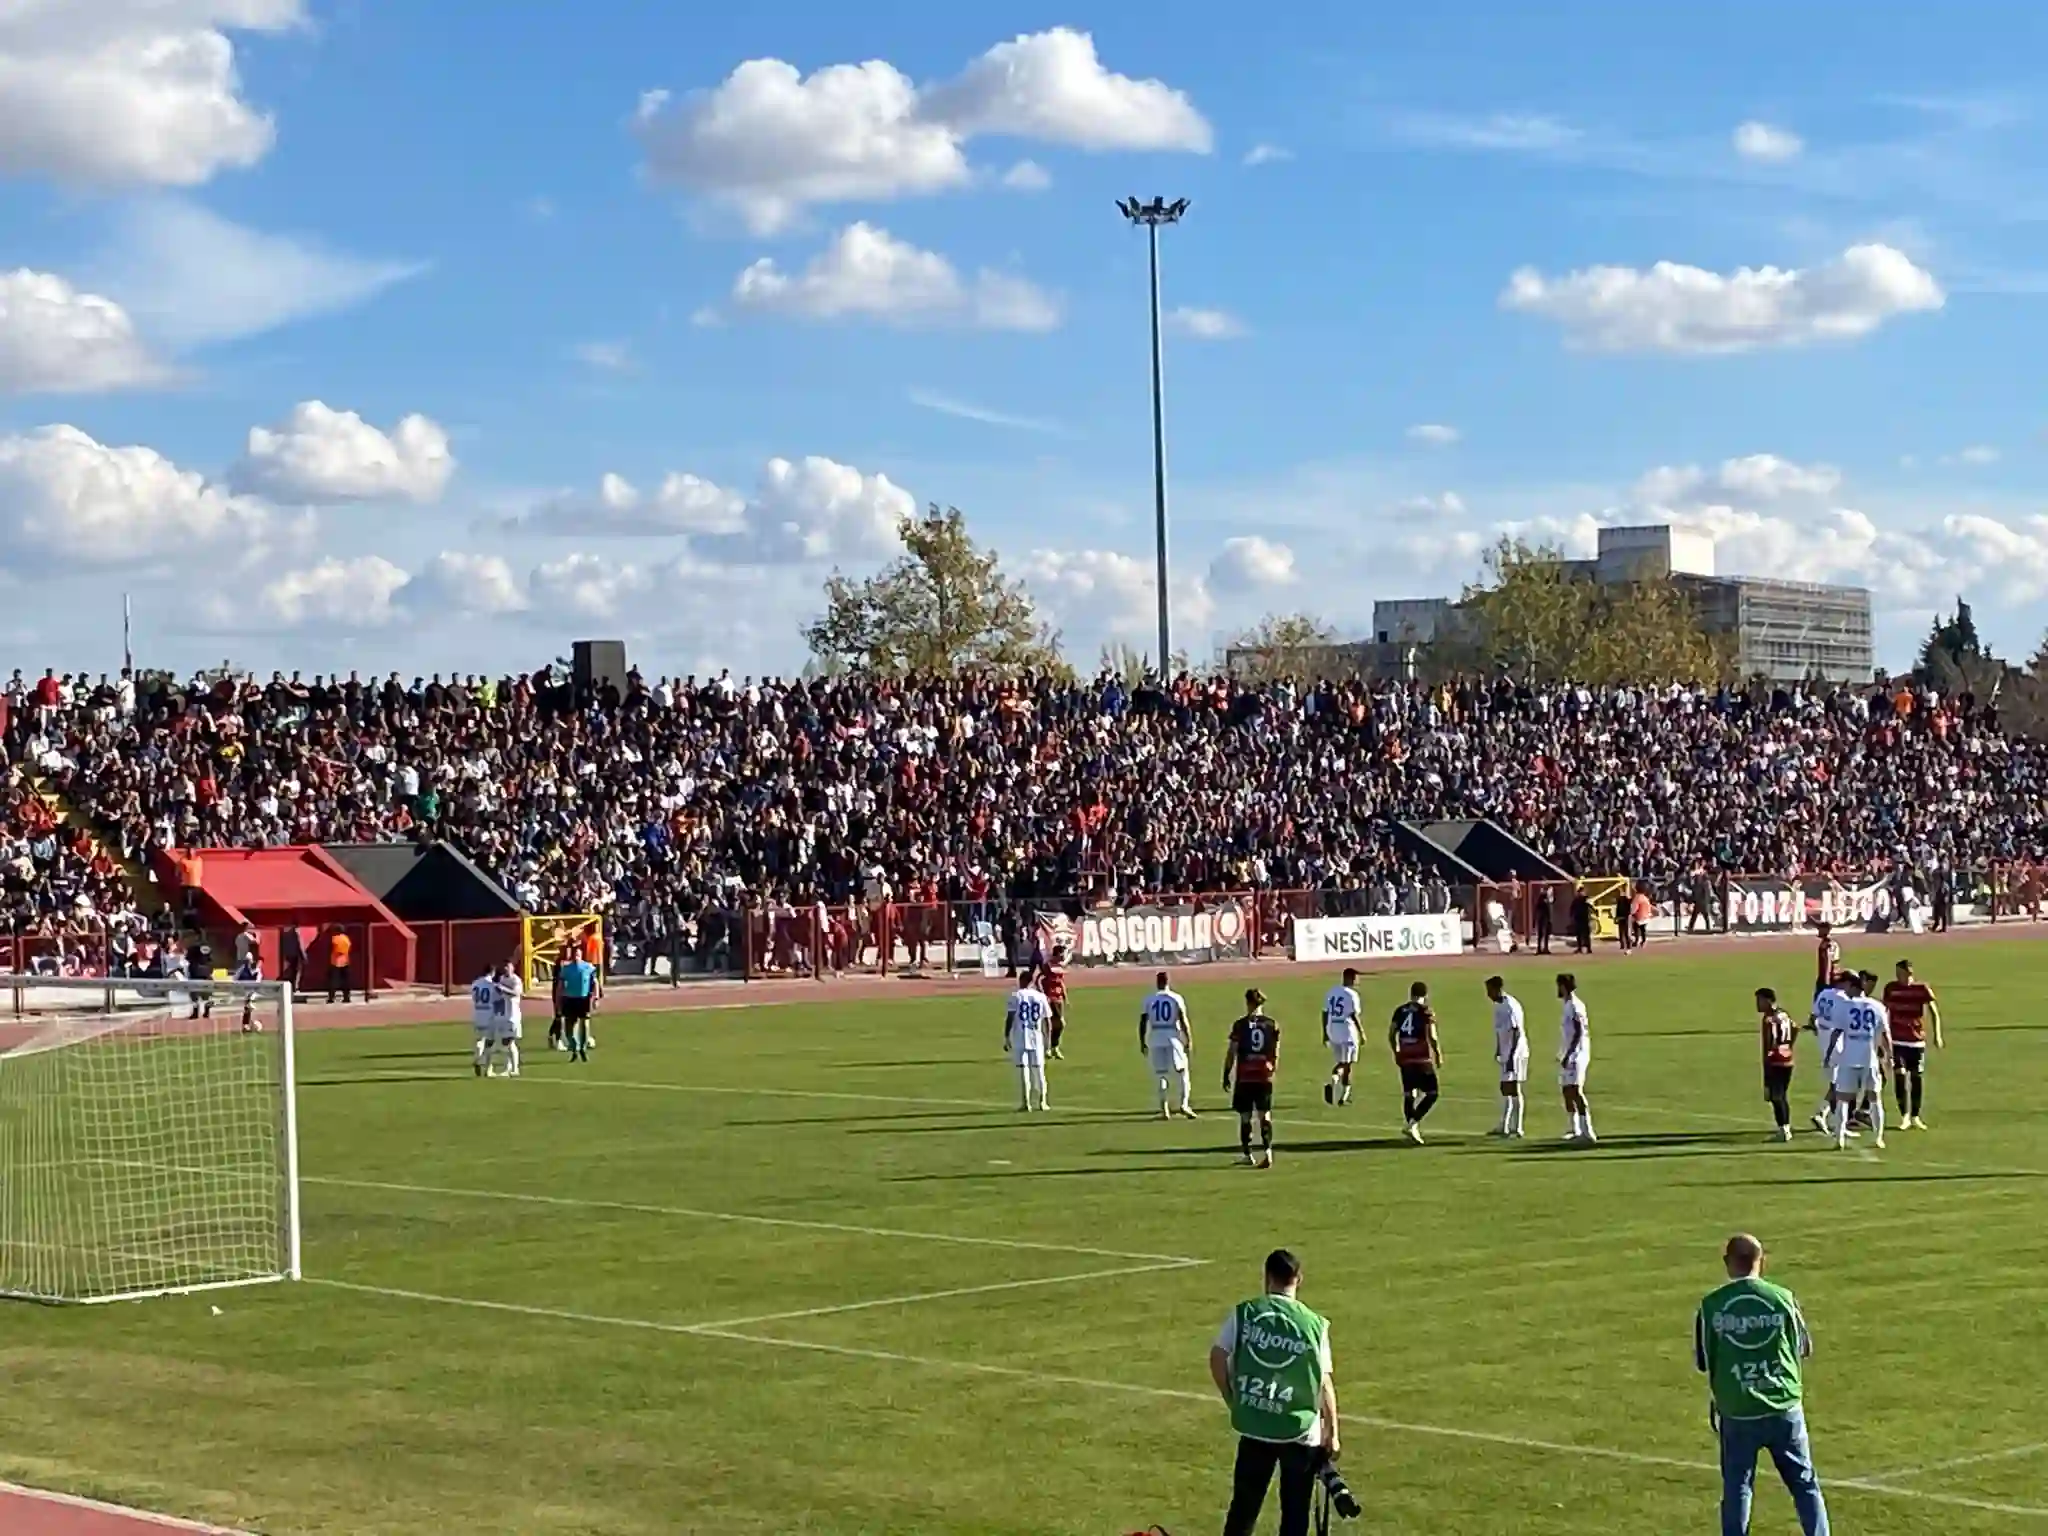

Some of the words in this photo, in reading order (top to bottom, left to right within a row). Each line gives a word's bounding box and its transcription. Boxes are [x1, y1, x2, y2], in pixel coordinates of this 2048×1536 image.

[1019, 1001, 1041, 1022] 88
[1151, 1000, 1172, 1022] 10
[1329, 996, 1345, 1017] 15
[1400, 1012, 1415, 1035] 4
[1849, 1008, 1876, 1032] 39
[1251, 1029, 1265, 1052] 9
[1237, 1375, 1293, 1402] 1214
